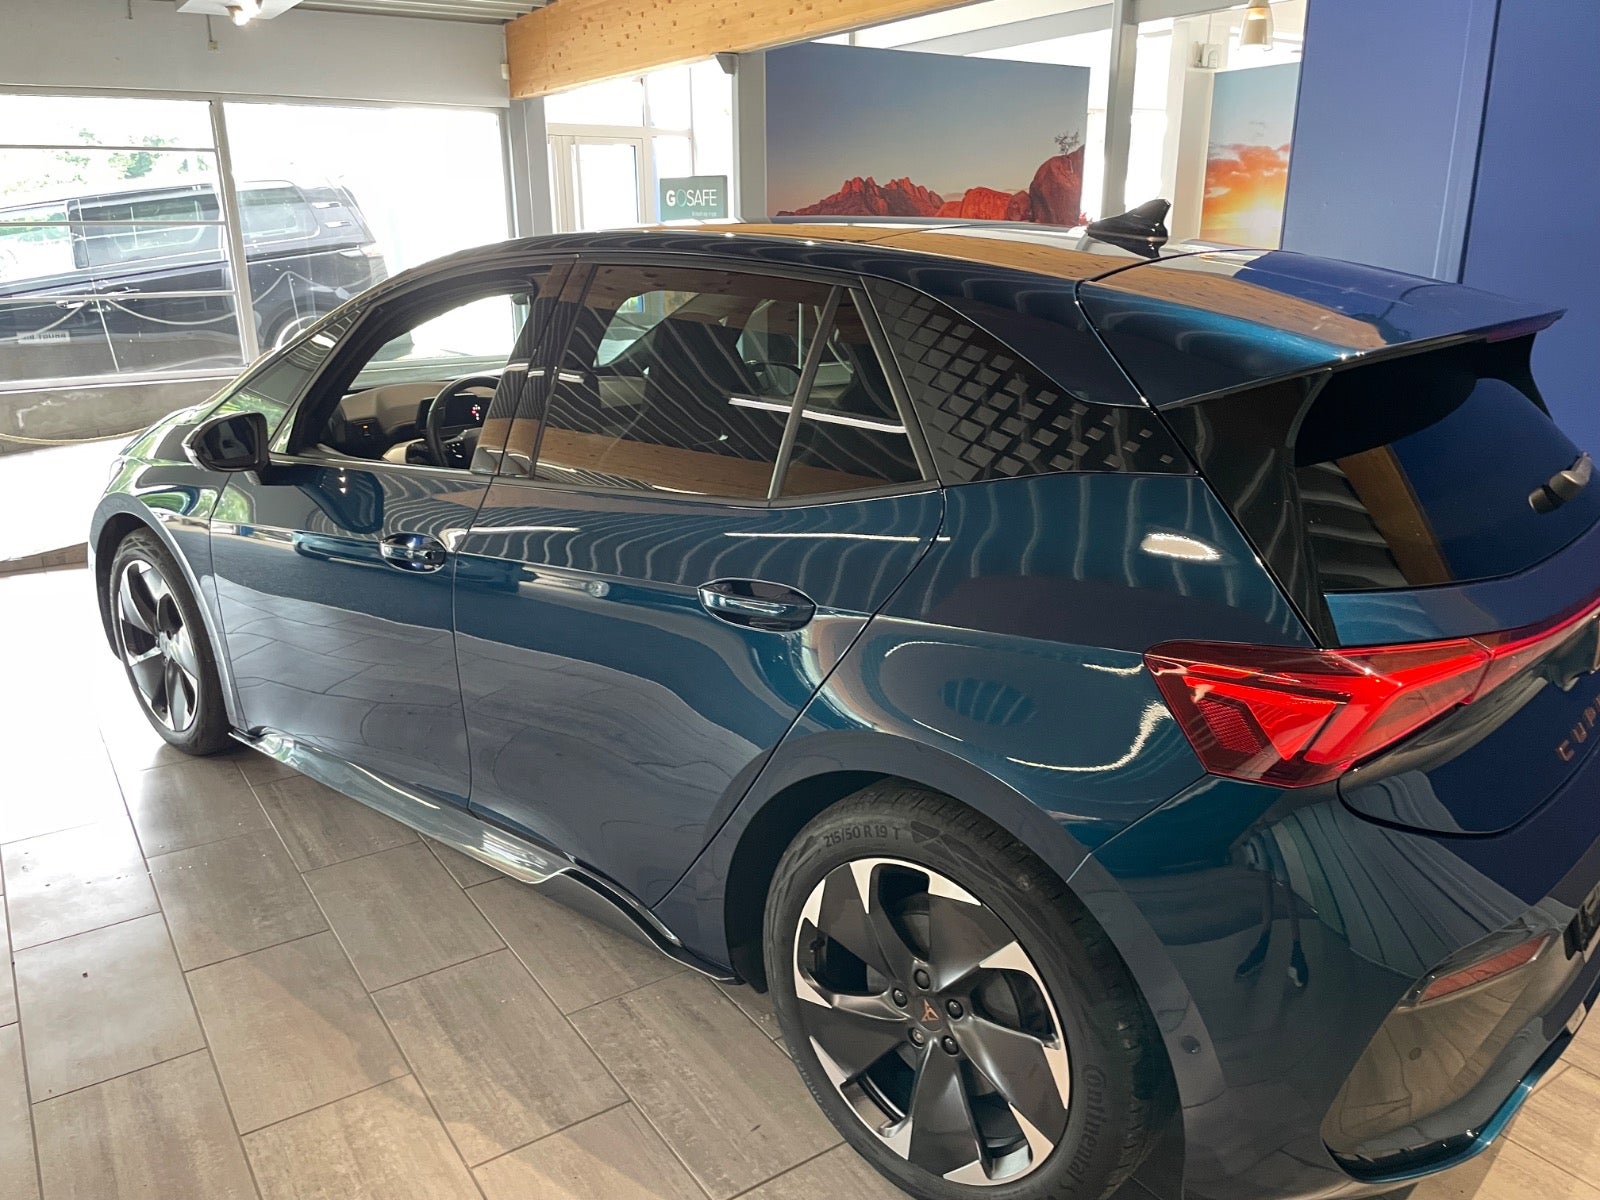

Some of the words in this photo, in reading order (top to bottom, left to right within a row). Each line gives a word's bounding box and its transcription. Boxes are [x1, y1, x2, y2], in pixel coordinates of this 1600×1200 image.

[666, 189, 717, 207] GOSAFE
[1557, 693, 1600, 761] CUP
[823, 825, 860, 847] 215/50
[863, 825, 873, 838] R
[876, 824, 888, 838] 19
[892, 826, 900, 840] T
[1067, 1064, 1106, 1184] Continental
